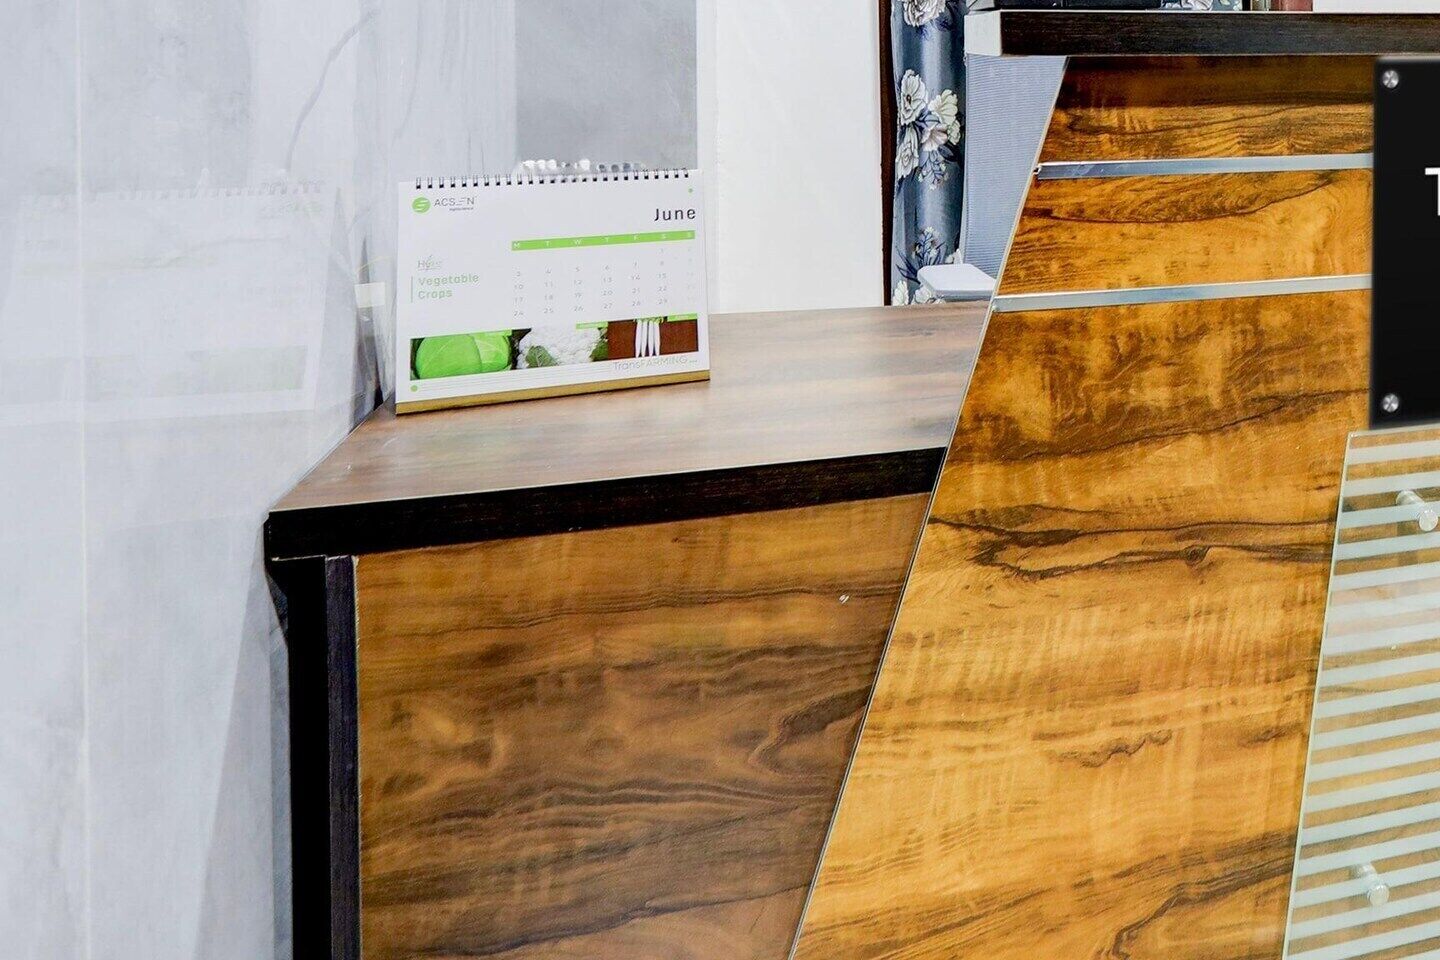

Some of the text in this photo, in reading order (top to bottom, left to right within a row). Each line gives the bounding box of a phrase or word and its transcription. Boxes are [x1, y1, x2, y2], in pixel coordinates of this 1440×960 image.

[654, 208, 696, 222] June
[418, 273, 480, 287] Vegetable
[418, 289, 453, 301] Crops
